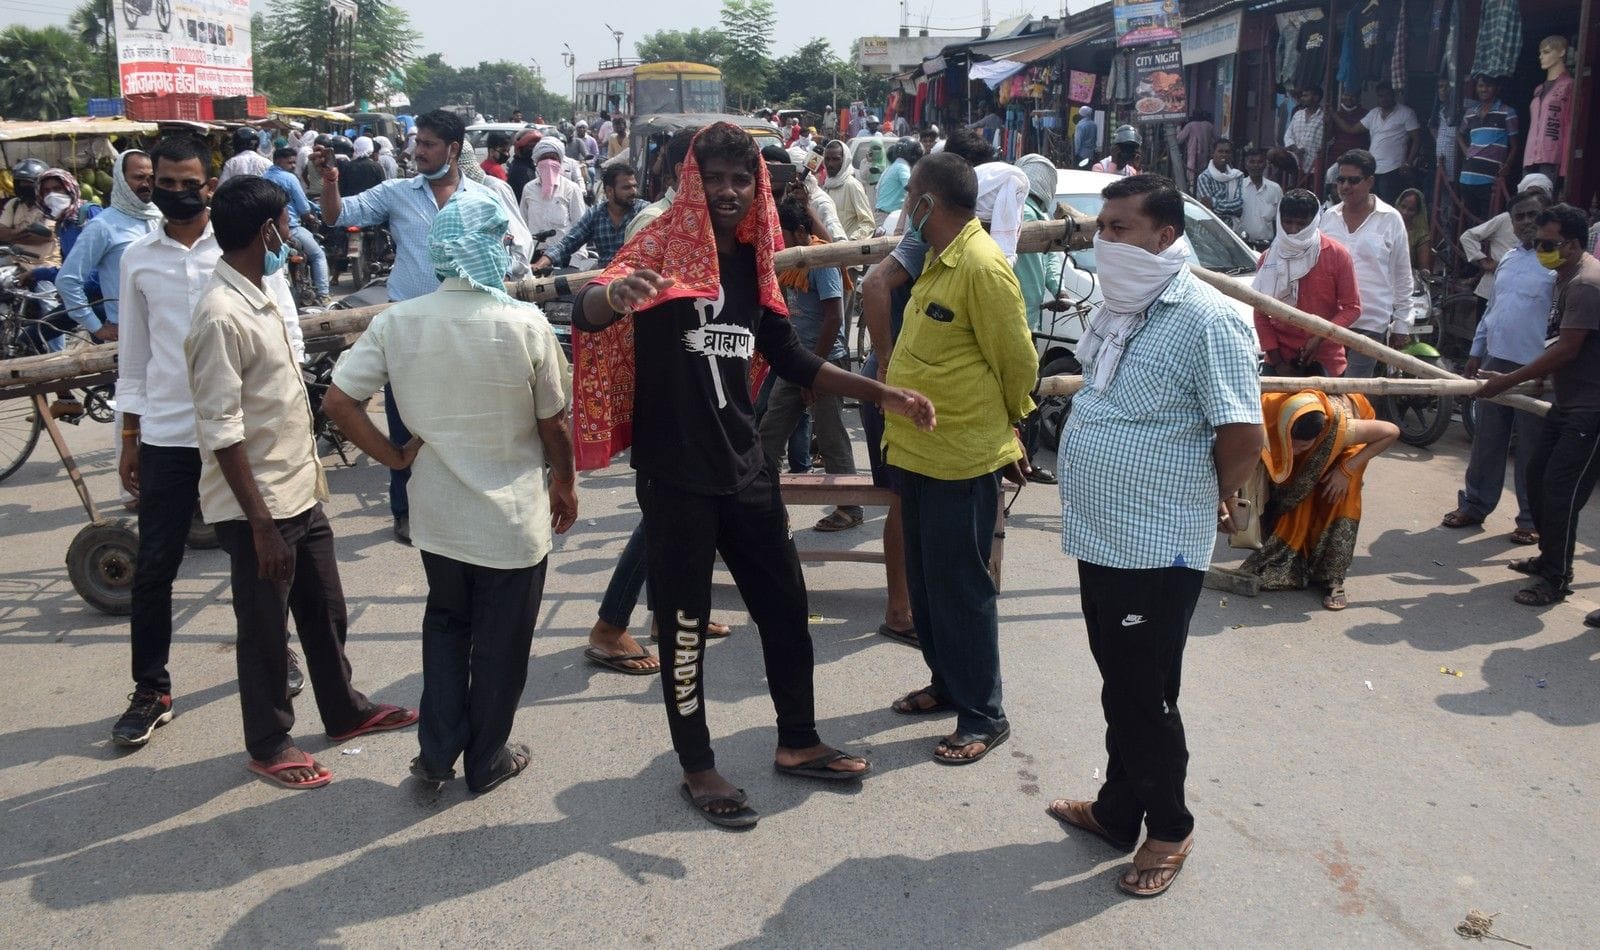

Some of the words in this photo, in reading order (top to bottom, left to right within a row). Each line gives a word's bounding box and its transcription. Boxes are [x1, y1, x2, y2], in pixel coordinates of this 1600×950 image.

[1135, 55, 1153, 67] CITY
[1154, 51, 1180, 64] NIGHT
[704, 329, 750, 354] ब्राह्मण
[673, 609, 699, 717] JORDAN
